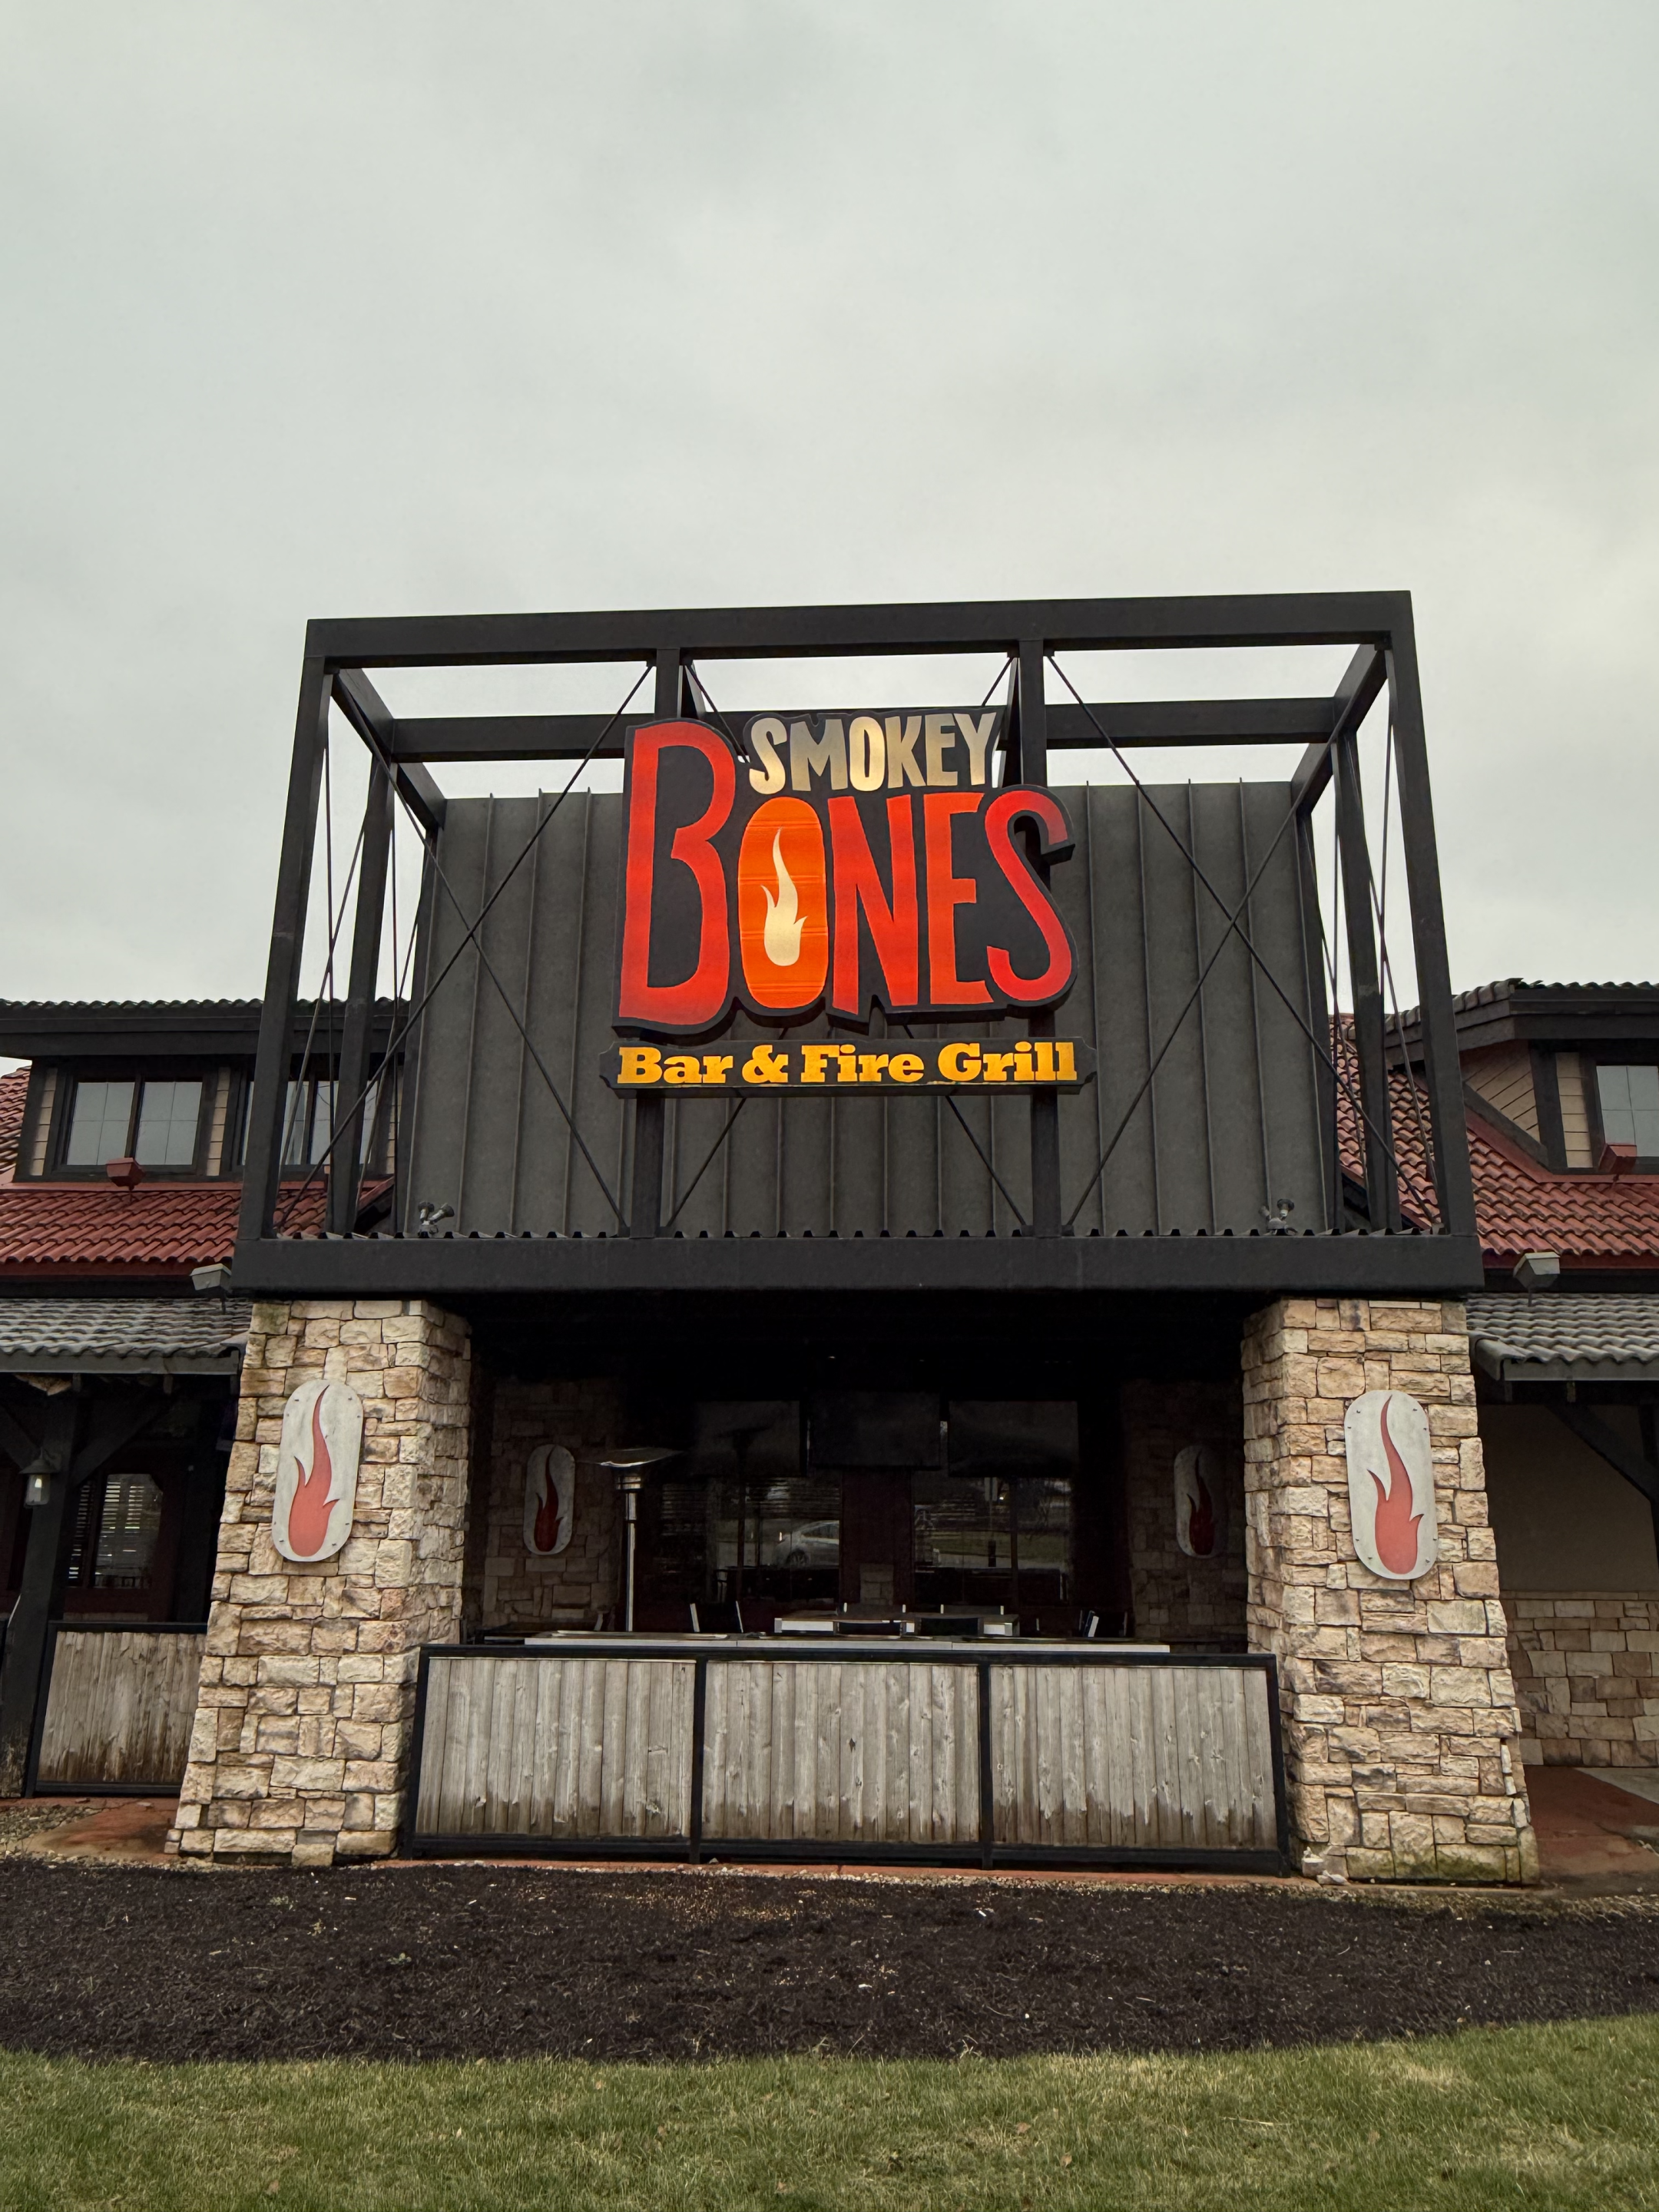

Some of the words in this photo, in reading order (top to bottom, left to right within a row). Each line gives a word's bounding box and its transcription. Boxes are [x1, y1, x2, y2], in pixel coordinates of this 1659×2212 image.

[750, 713, 998, 794] SMOKEY
[619, 721, 1072, 1025] BONES
[618, 1047, 733, 1084] Bar
[742, 1045, 789, 1084] &
[801, 1045, 925, 1084] Fire
[938, 1041, 1078, 1081] Grill
